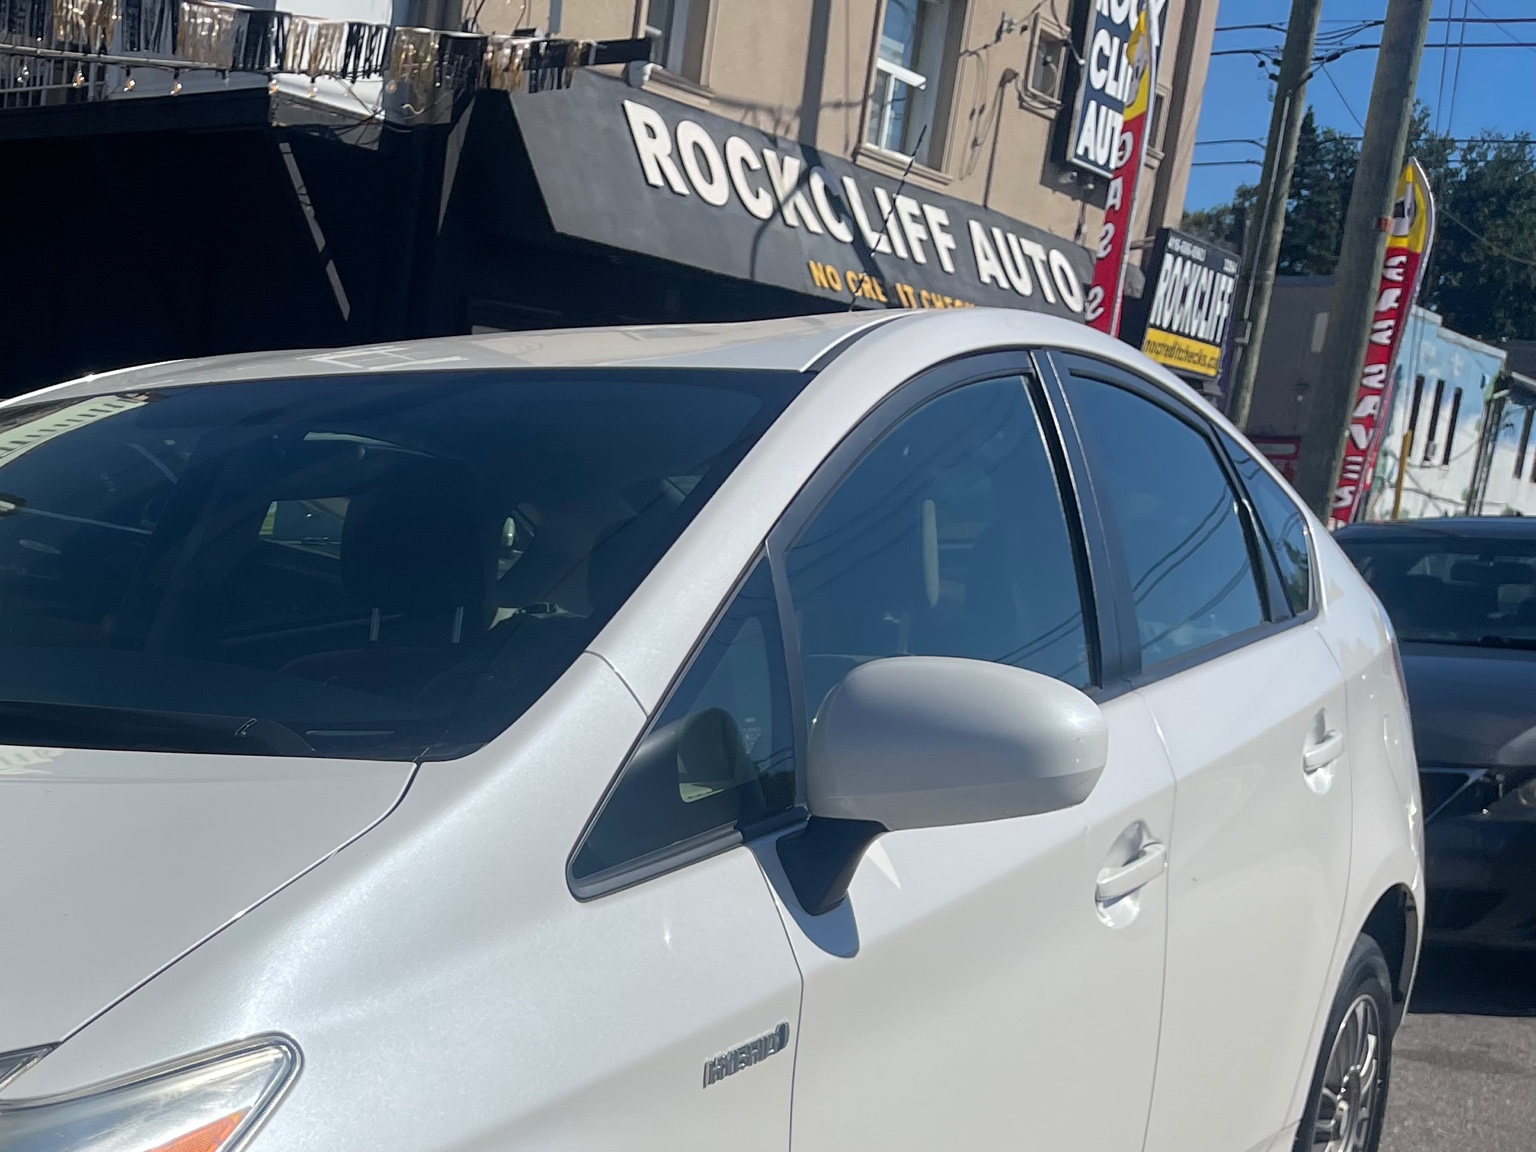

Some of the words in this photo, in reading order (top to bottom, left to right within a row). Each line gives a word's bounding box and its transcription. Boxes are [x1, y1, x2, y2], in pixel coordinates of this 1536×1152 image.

[1076, 100, 1125, 171] AUT
[623, 99, 956, 273] ROCKCLIFF
[968, 218, 1084, 314] AUTO
[808, 260, 843, 292] NO
[1149, 252, 1235, 344] ROCKCLIFF
